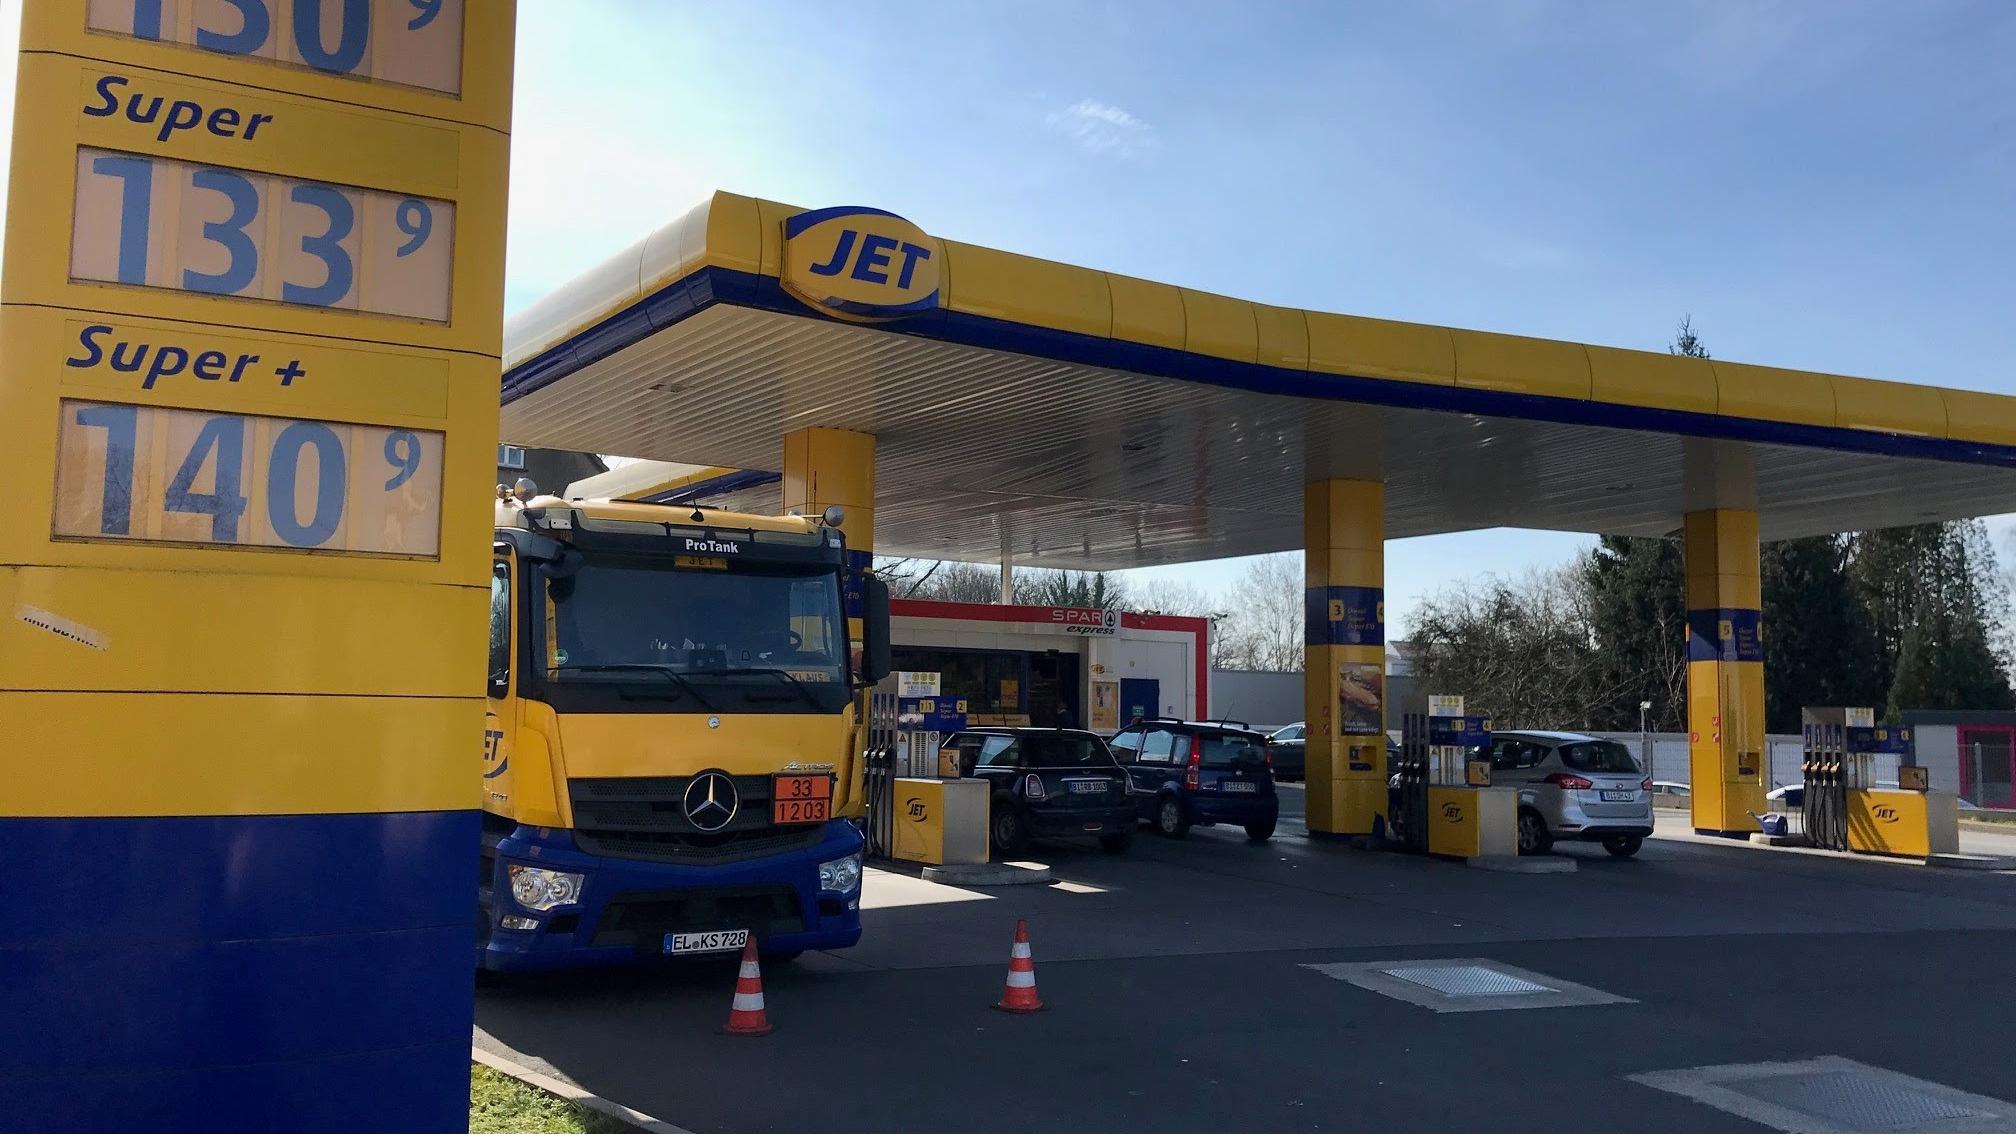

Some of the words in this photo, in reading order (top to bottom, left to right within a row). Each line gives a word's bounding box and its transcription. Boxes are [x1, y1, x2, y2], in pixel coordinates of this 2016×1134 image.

[83, 75, 273, 142] Super
[809, 229, 931, 289] JET
[66, 325, 260, 390] Super
[275, 360, 306, 386] +
[685, 538, 739, 554] ProTank
[1053, 610, 1101, 623] SPAR
[1334, 605, 1341, 616] 3
[1066, 625, 1115, 635] express
[1724, 625, 1730, 636] 5
[792, 779, 812, 797] 33
[780, 801, 824, 821] 1203
[908, 804, 925, 816] JET
[1445, 807, 1461, 817] JET
[1875, 808, 1897, 818] JET
[721, 932, 746, 947] 728
